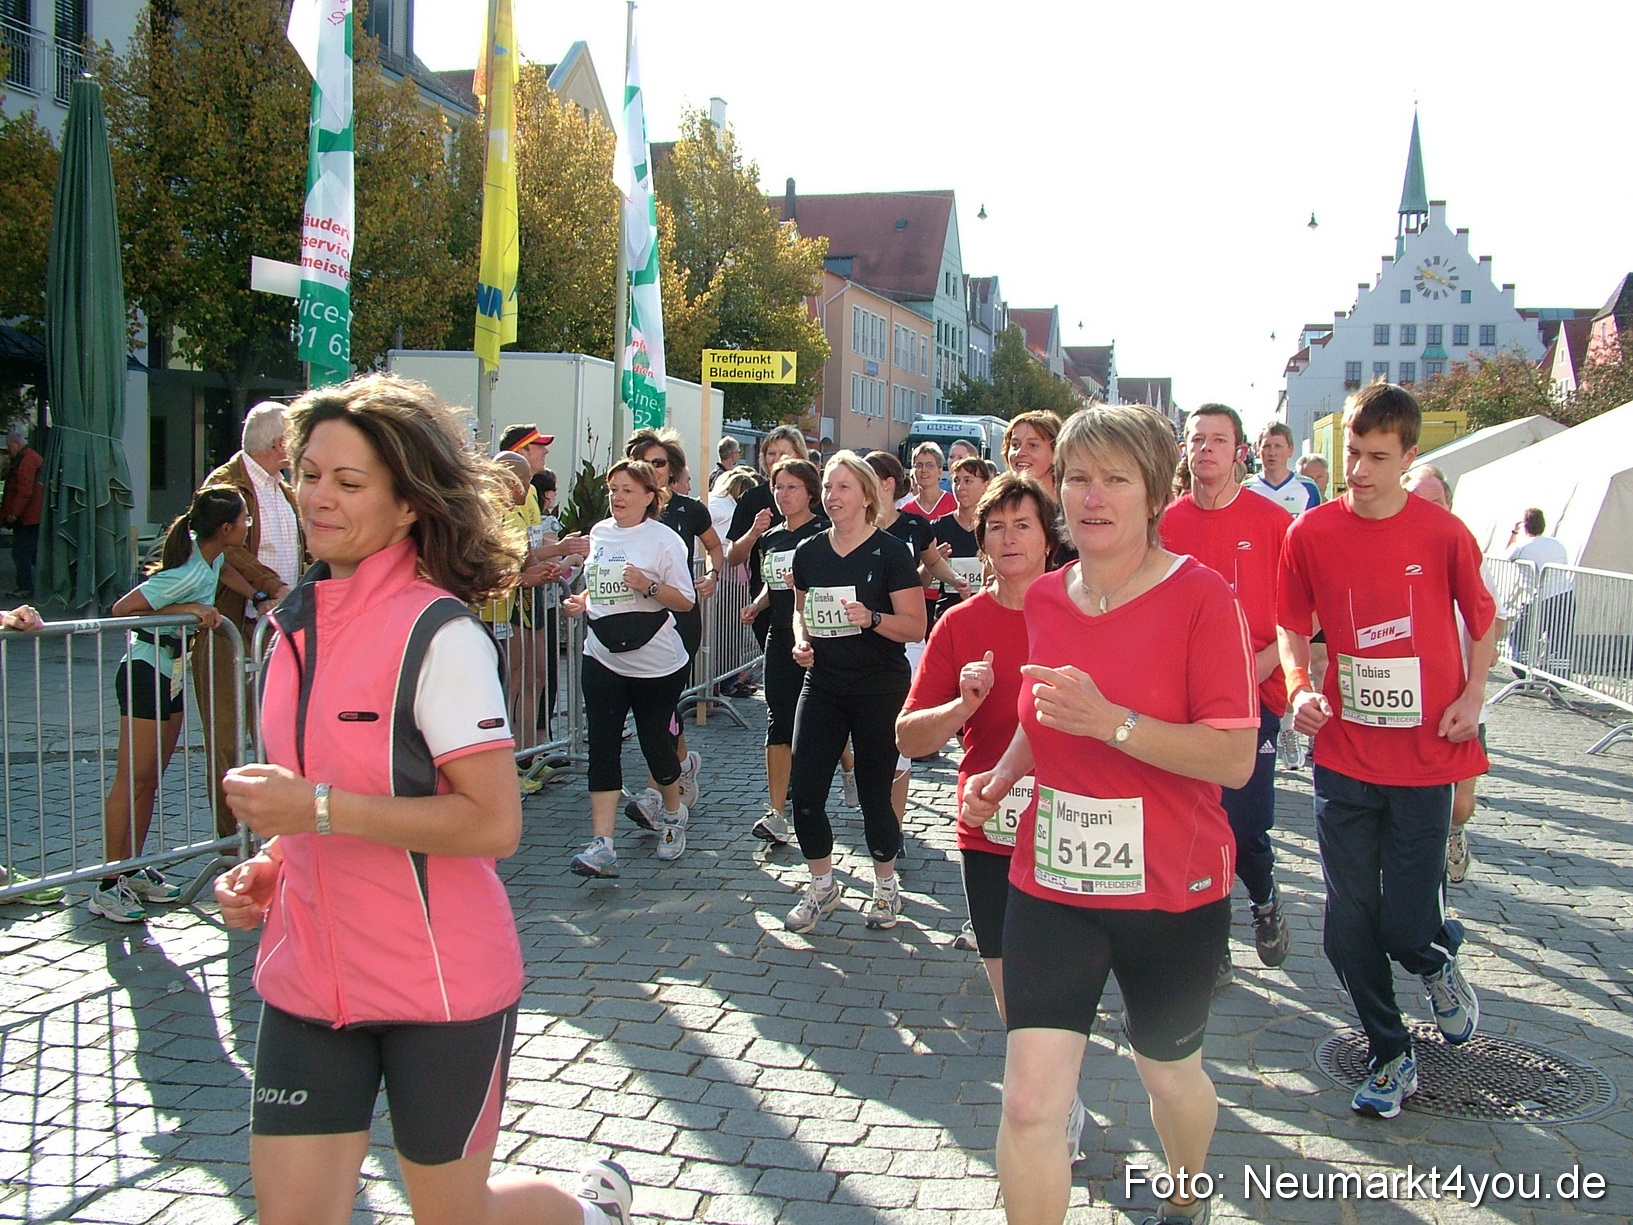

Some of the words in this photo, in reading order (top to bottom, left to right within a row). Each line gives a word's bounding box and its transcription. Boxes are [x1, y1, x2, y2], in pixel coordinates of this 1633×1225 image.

[709, 352, 772, 366] Treffpunkt
[709, 367, 775, 381] Bladenight
[814, 592, 835, 603] Gisela
[817, 609, 848, 624] 511
[1370, 626, 1396, 641] DEHN
[1355, 663, 1391, 679] Tobias
[1360, 688, 1414, 709] 5050
[1056, 799, 1113, 829] Margari
[1058, 837, 1134, 869] 5124
[1094, 879, 1142, 890] PFLEIDERER
[256, 1086, 309, 1105] ODLO
